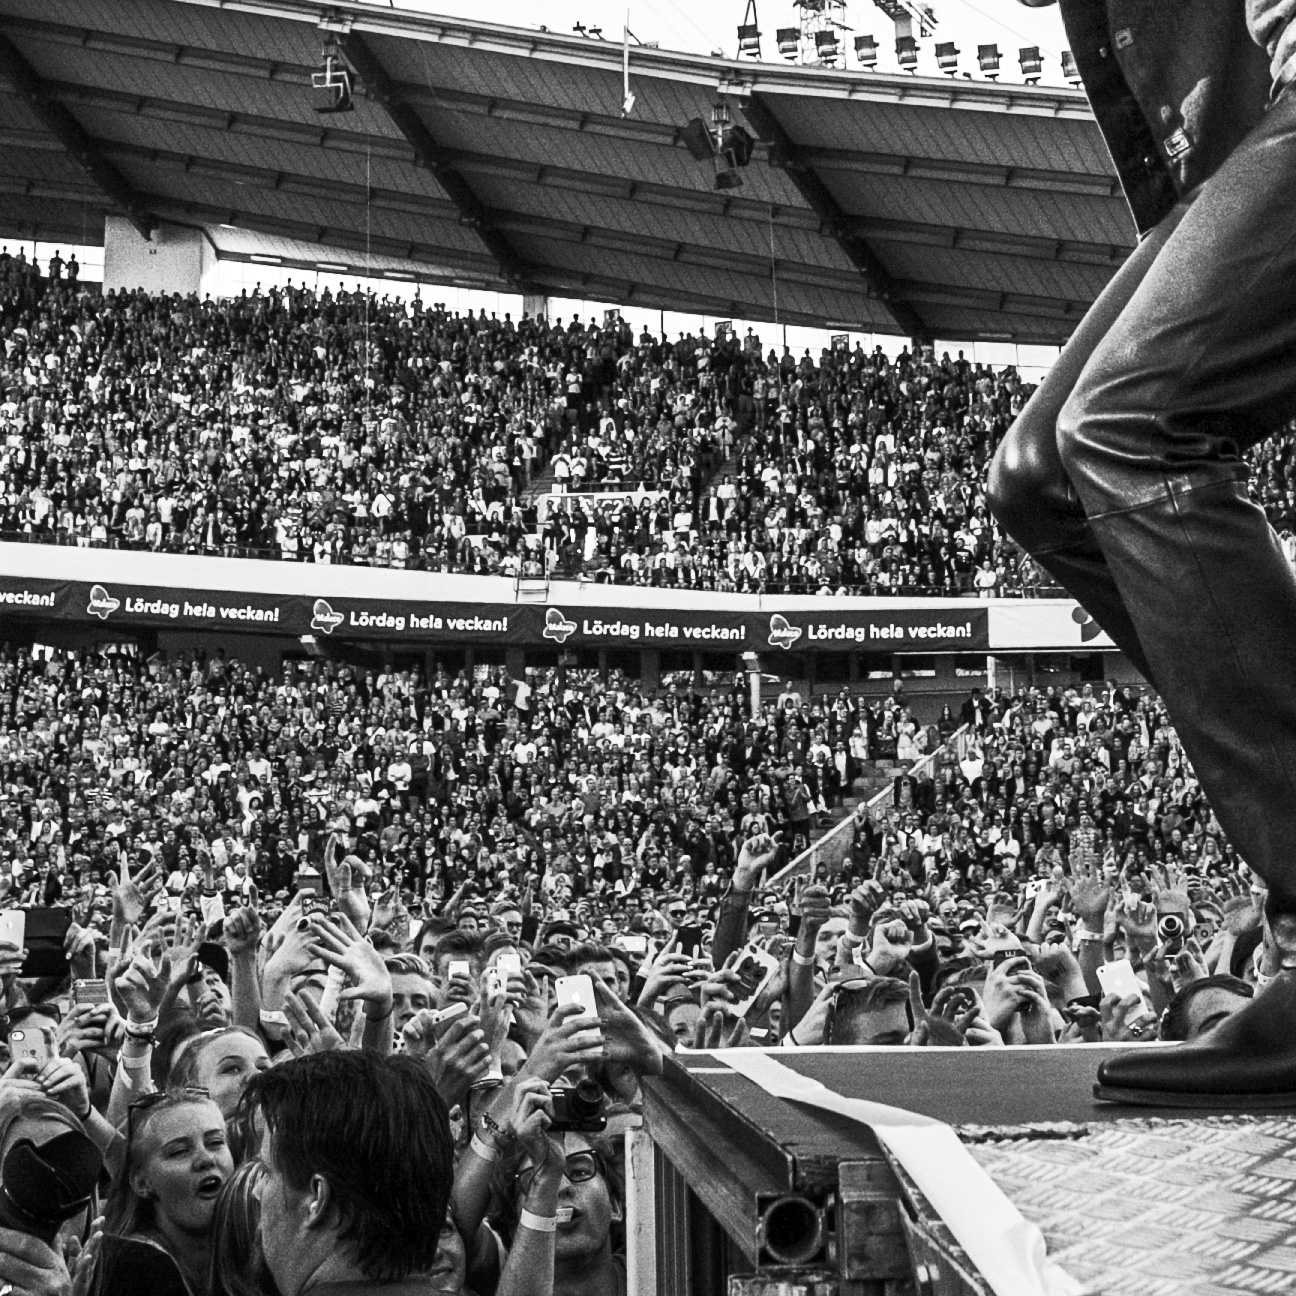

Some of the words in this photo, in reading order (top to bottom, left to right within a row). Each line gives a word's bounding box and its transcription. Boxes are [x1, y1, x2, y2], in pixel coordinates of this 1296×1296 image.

[125, 598, 179, 618] Lördag
[183, 601, 216, 618] hela
[220, 606, 279, 622] veckan!
[350, 611, 406, 631] Lördag
[410, 614, 443, 630] hela
[447, 616, 508, 632] veckan!
[583, 620, 640, 639] Lördag
[645, 622, 678, 638] hela
[683, 624, 745, 640] veckan!
[808, 623, 865, 642] Lördag
[869, 623, 904, 639] hela
[908, 622, 972, 639] veckan!
